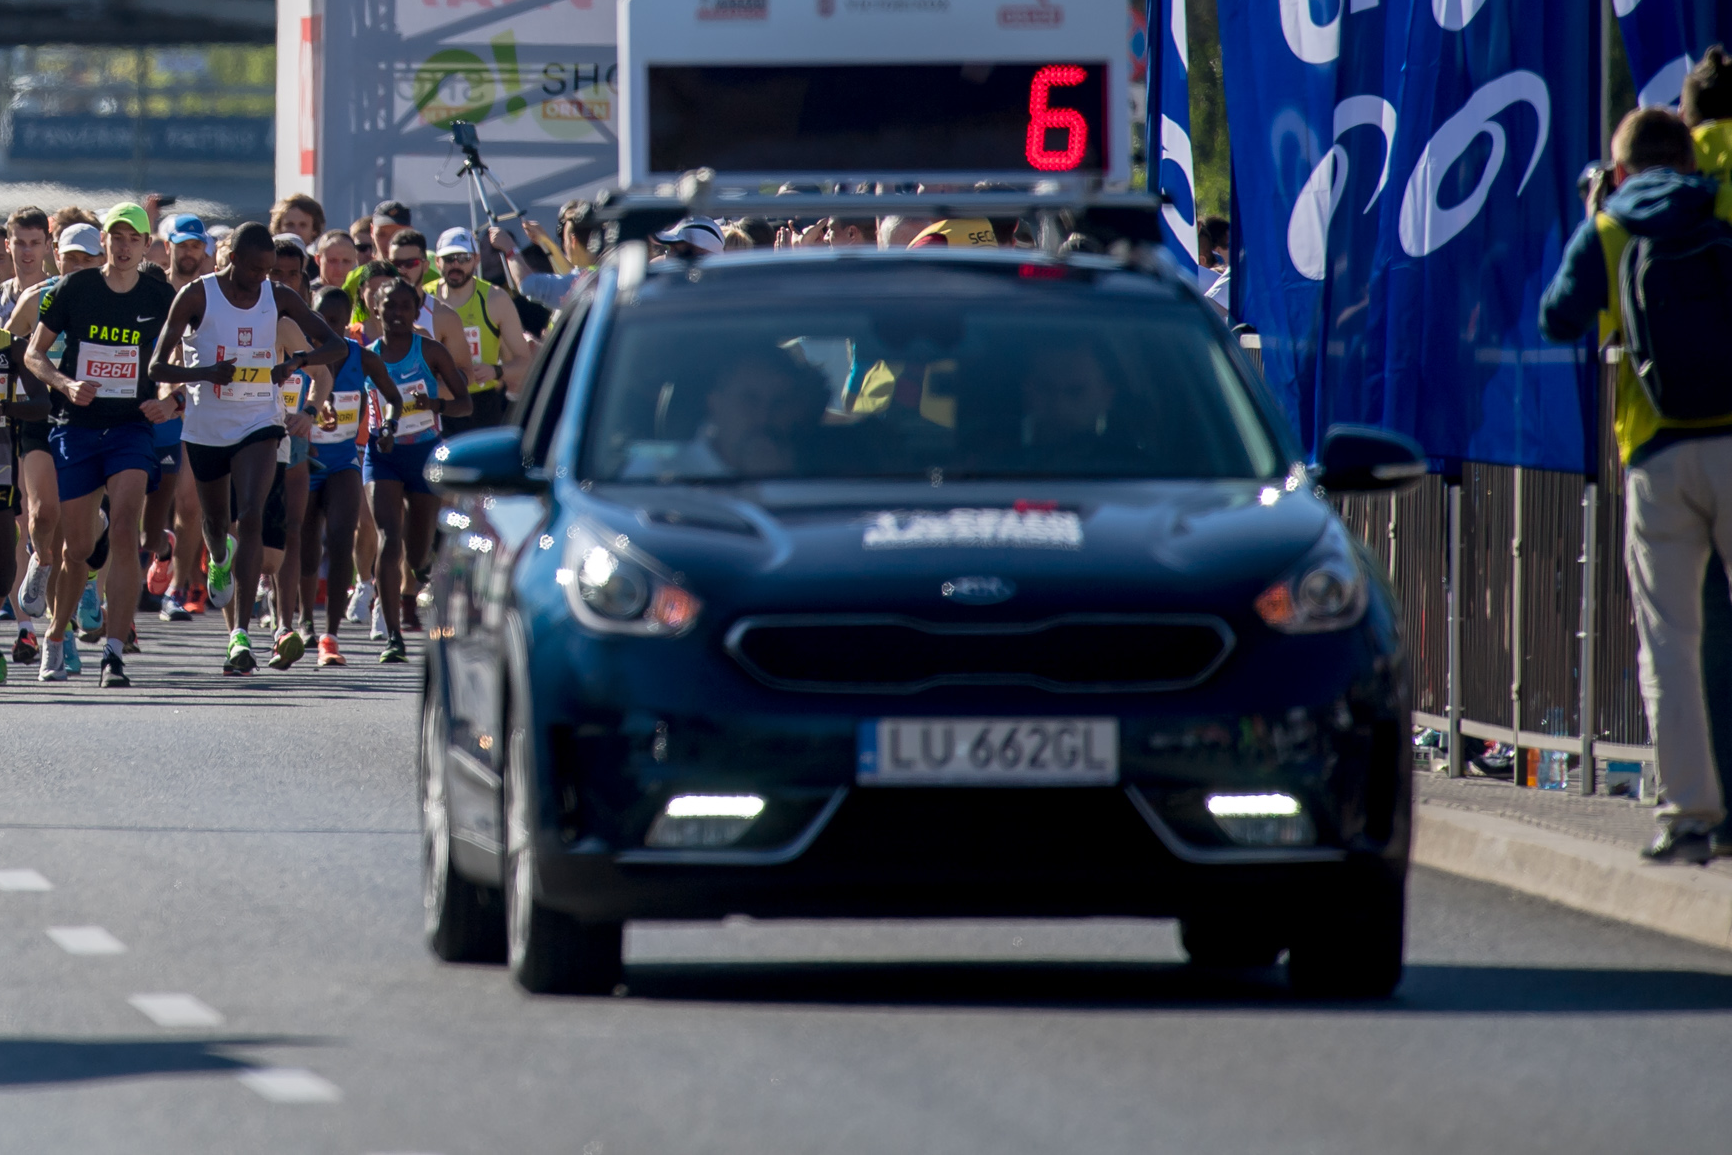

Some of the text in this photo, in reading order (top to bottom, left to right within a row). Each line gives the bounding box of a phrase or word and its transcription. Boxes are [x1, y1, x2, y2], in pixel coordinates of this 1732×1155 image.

[1025, 64, 1089, 172] 6
[88, 324, 141, 345] PACER
[89, 362, 133, 378] 6264
[239, 368, 259, 382] 17
[886, 724, 1108, 772] LU 662GL
